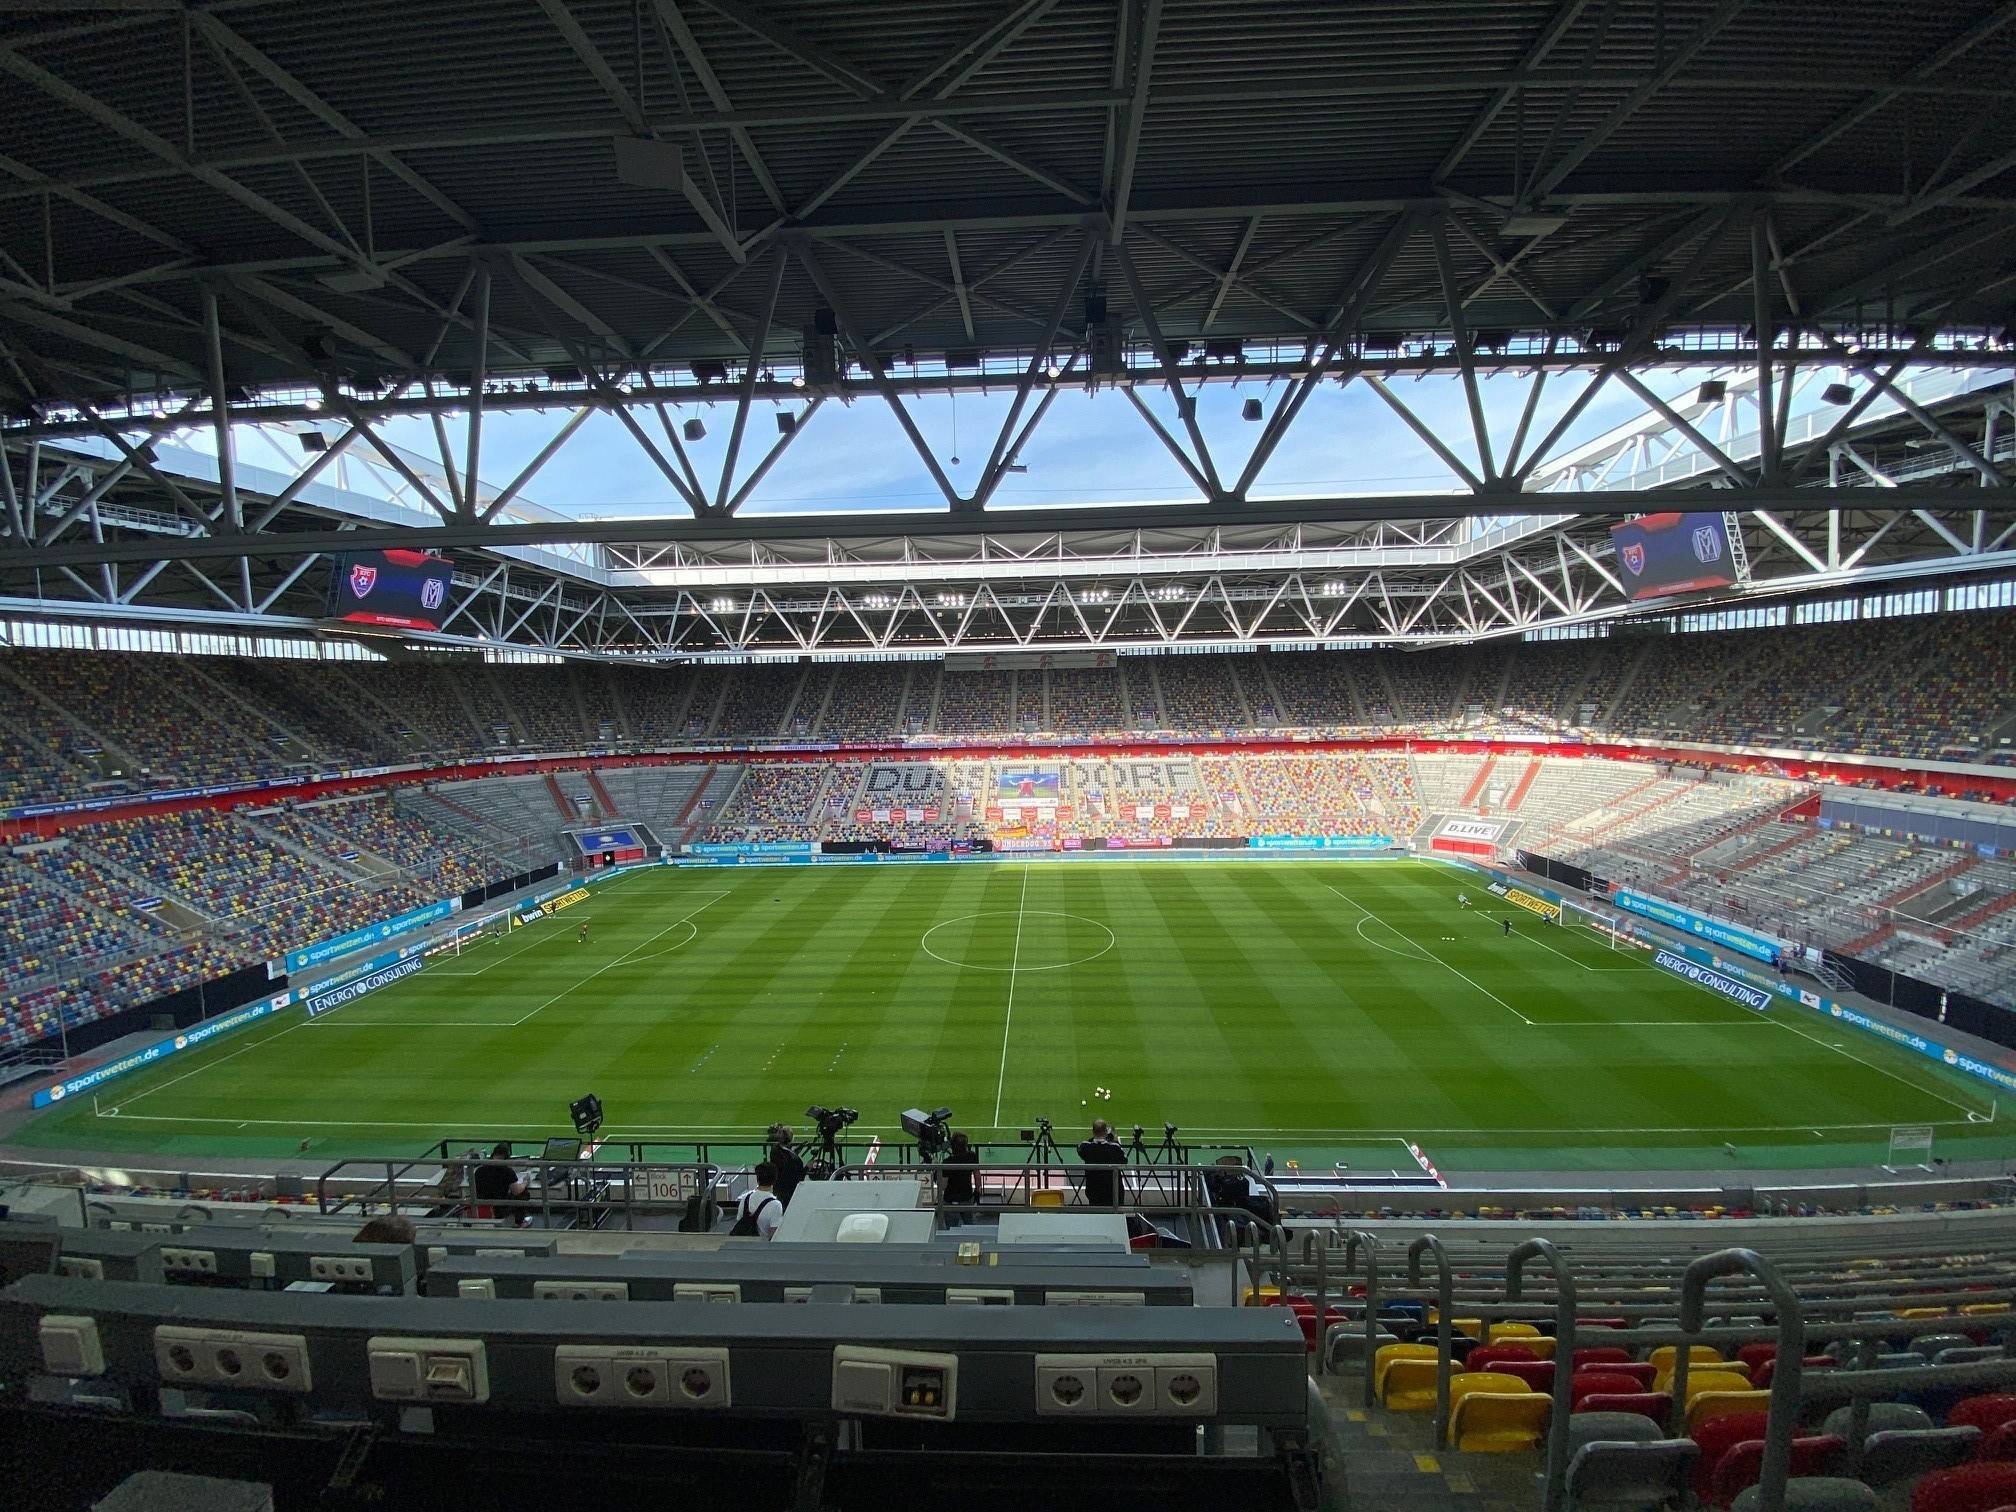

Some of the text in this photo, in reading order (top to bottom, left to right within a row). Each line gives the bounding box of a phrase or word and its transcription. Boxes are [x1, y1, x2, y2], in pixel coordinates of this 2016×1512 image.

[1448, 824, 1491, 835] D.LIVE
[521, 908, 544, 923] bwin
[544, 889, 589, 913] SPRTWETTEN
[1507, 889, 1560, 917] SPORTWETTEN
[1631, 898, 1687, 926] sportwetten.de
[1704, 926, 1772, 956] sportwetten.de
[309, 961, 374, 994] sportwetten.de
[316, 958, 423, 1012] ENERGY CONSULTING
[1655, 951, 1763, 1007] ENERGY CONSULTING
[1720, 960, 1792, 996] sportwetten.de
[187, 1006, 265, 1043] sportwetten.de
[1842, 1009, 1928, 1051] sportwetten.de
[67, 1047, 160, 1093] sportwetten.de
[652, 1183, 678, 1198] 106
